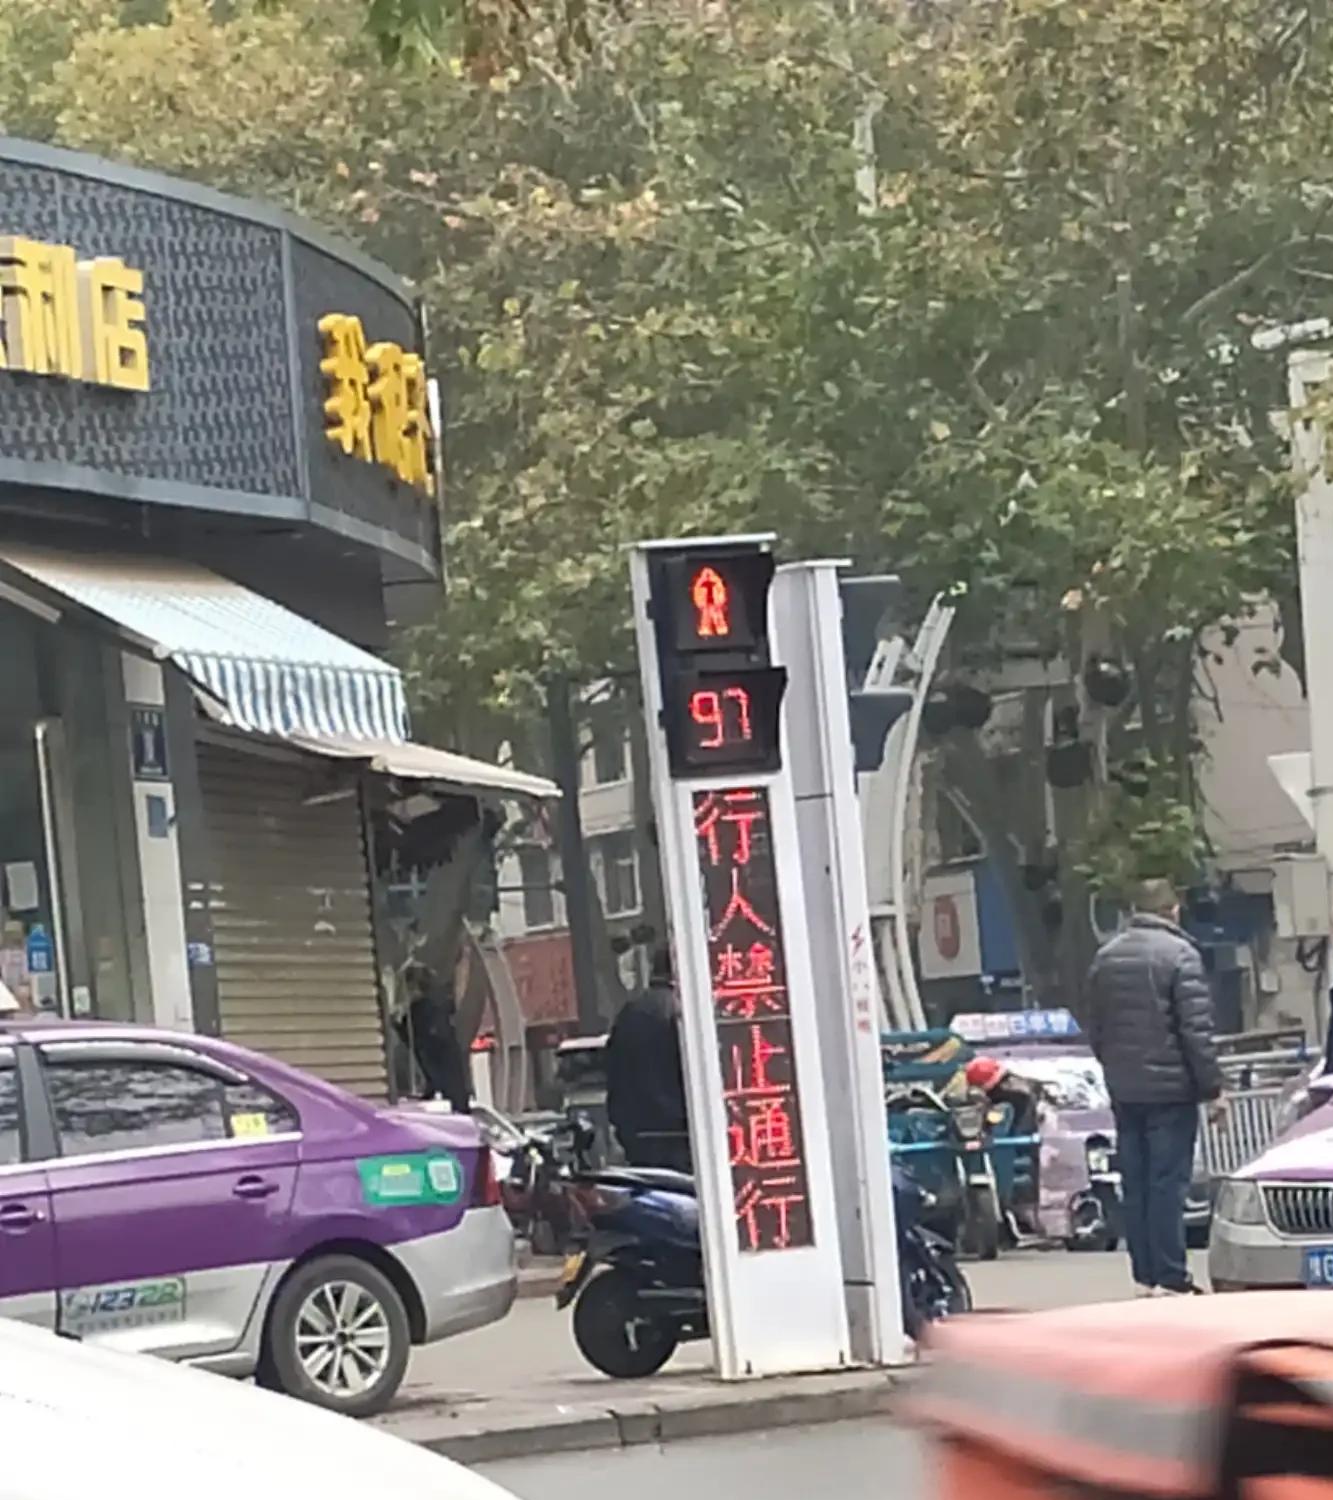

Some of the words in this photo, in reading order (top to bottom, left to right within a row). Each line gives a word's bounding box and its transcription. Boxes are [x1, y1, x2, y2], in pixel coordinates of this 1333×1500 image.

[0, 236, 150, 391] 利店
[690, 687, 752, 749] 97
[694, 791, 805, 1252] 行人禁止通行
